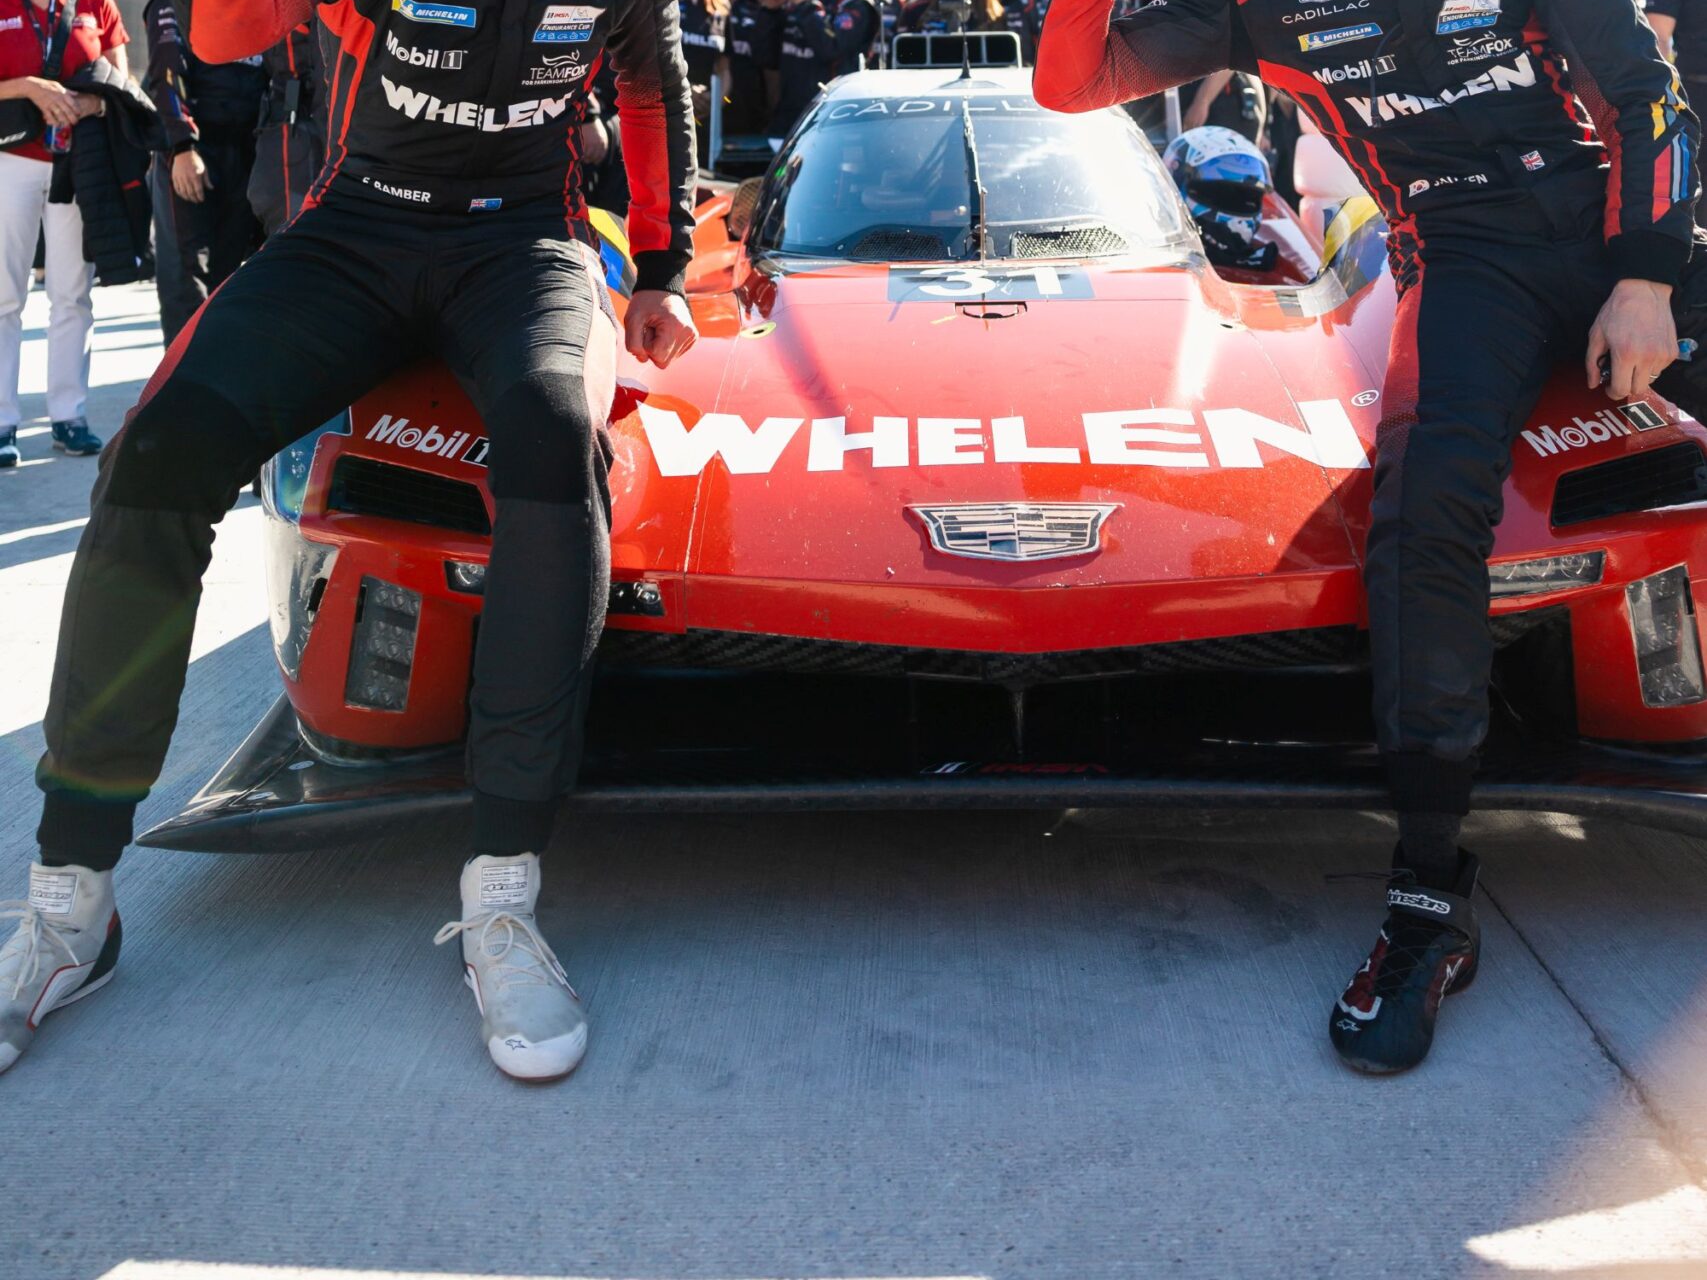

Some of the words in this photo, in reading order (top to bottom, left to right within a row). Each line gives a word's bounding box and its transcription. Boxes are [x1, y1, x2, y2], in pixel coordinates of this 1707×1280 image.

[416, 8, 469, 21] MICHELIN
[386, 29, 439, 68] Mobil
[1323, 26, 1372, 42] MICHELIN
[1313, 58, 1372, 86] Mobil
[381, 74, 576, 132] WHELEN
[829, 100, 1038, 120] CADILL
[918, 267, 1064, 297] 31
[365, 414, 470, 459] Mobil
[635, 398, 1371, 478] WHELEN
[1520, 409, 1632, 458] Mobil
